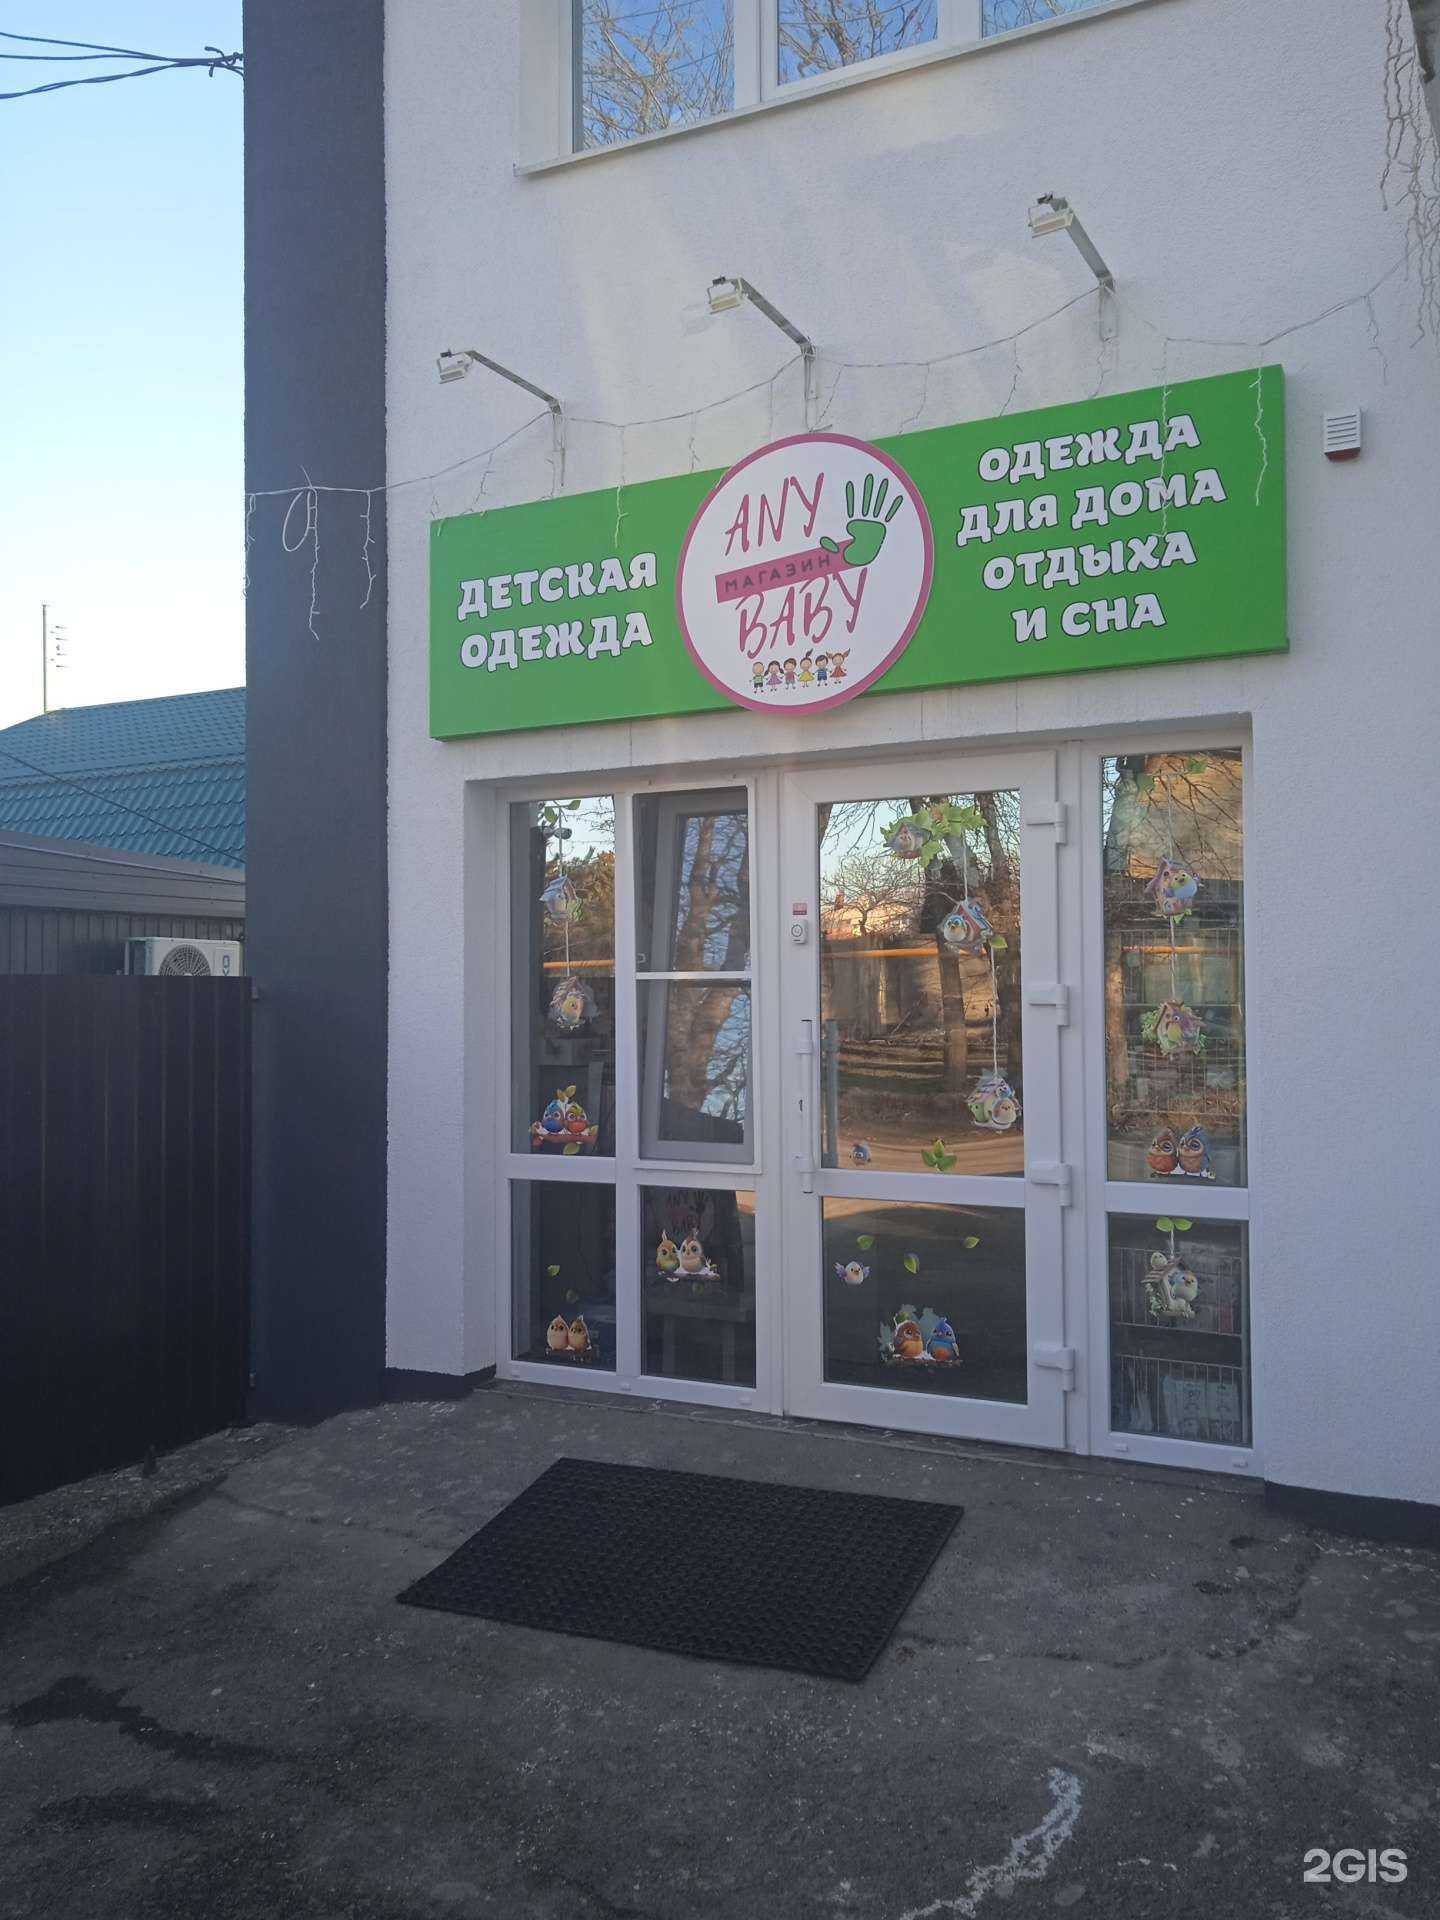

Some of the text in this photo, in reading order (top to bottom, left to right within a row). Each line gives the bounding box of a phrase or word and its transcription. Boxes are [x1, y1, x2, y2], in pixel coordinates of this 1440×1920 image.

[978, 414, 1201, 484] ОДЕЖДА
[725, 472, 825, 556] ANY
[956, 468, 1227, 547] ДЛЯ ДОМА
[457, 552, 658, 622] ДЕТСКАЯ
[724, 553, 831, 593] МАГАЗИН
[982, 530, 1198, 590] ОТДЫХА
[460, 611, 654, 673] ОДЕЖДА
[735, 567, 868, 660] BABY
[1011, 593, 1166, 643] И СНА
